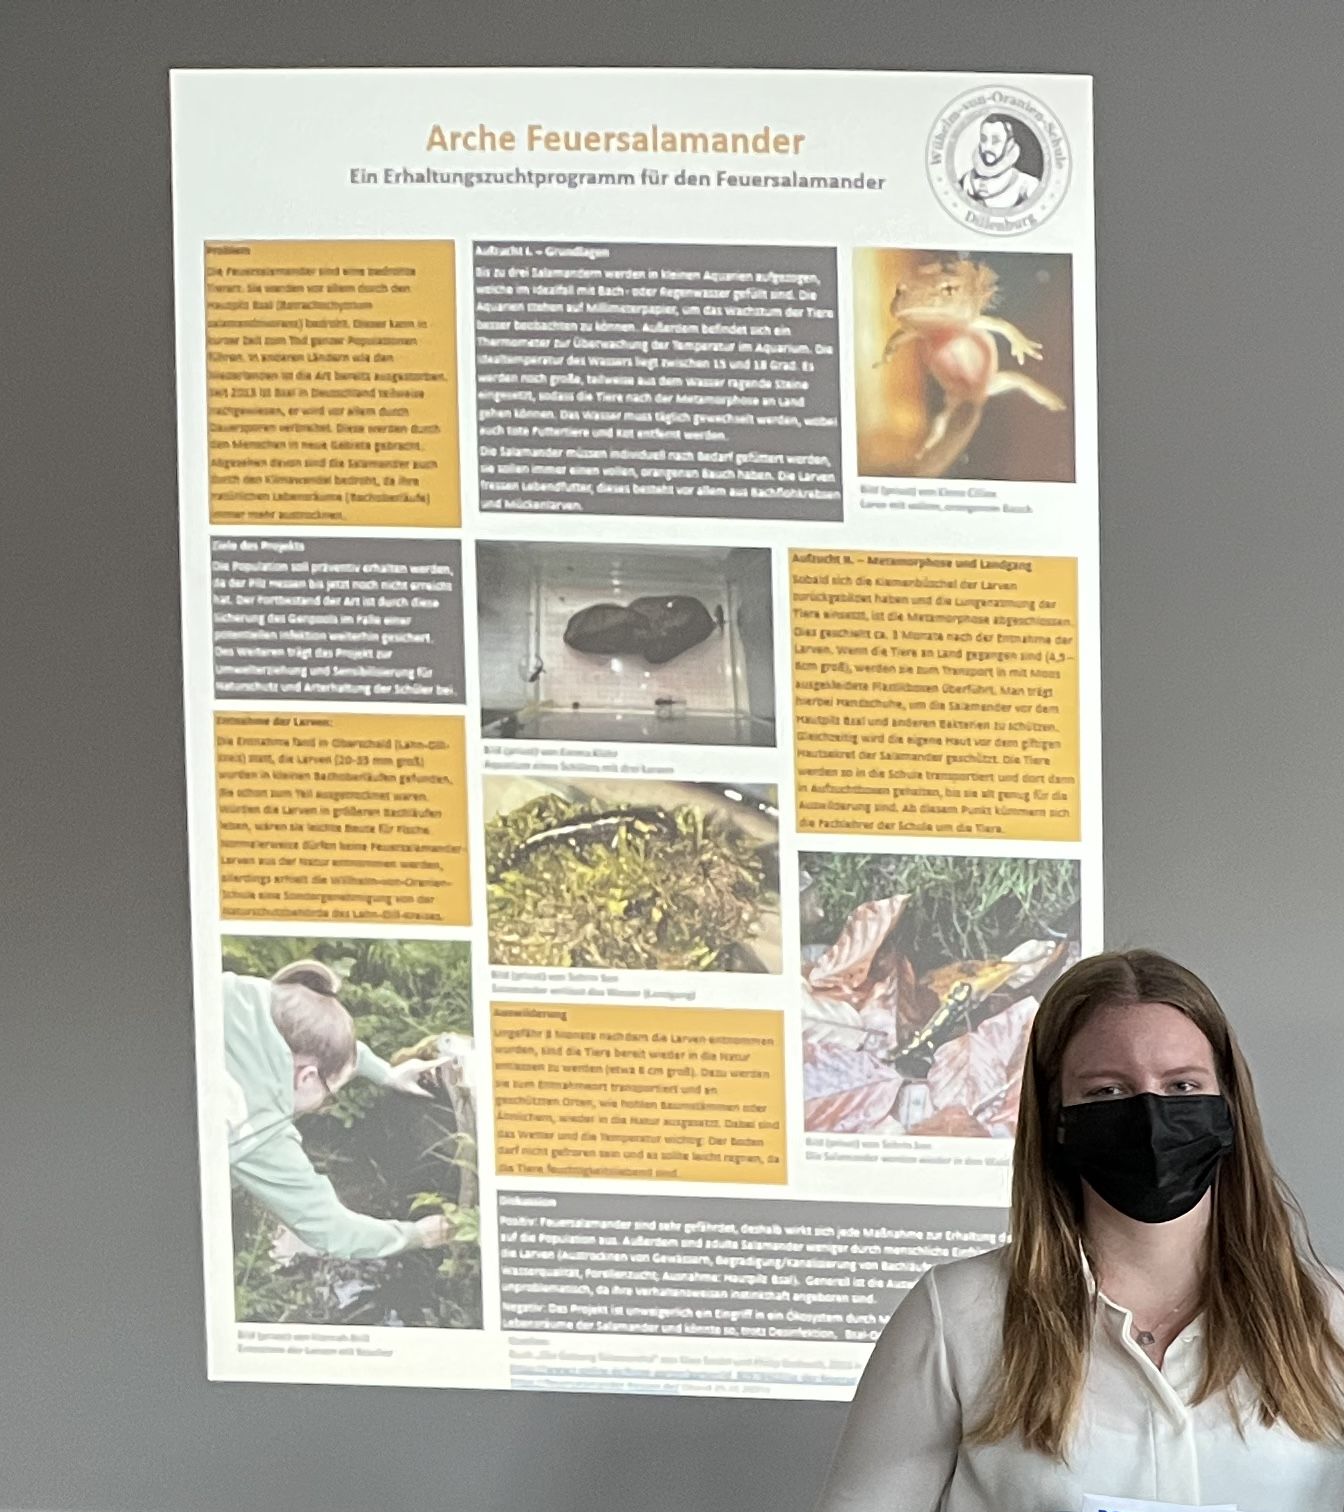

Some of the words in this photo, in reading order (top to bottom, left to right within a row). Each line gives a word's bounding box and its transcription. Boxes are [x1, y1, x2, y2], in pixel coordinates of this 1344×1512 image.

[427, 124, 516, 152] Arche
[527, 123, 806, 154] Feuersalamander
[350, 168, 378, 184] Ein
[383, 167, 635, 188] Erhaltungszuchtprogramm
[641, 168, 668, 186] für
[674, 169, 710, 186] den
[716, 170, 887, 190] Feuersalamander
